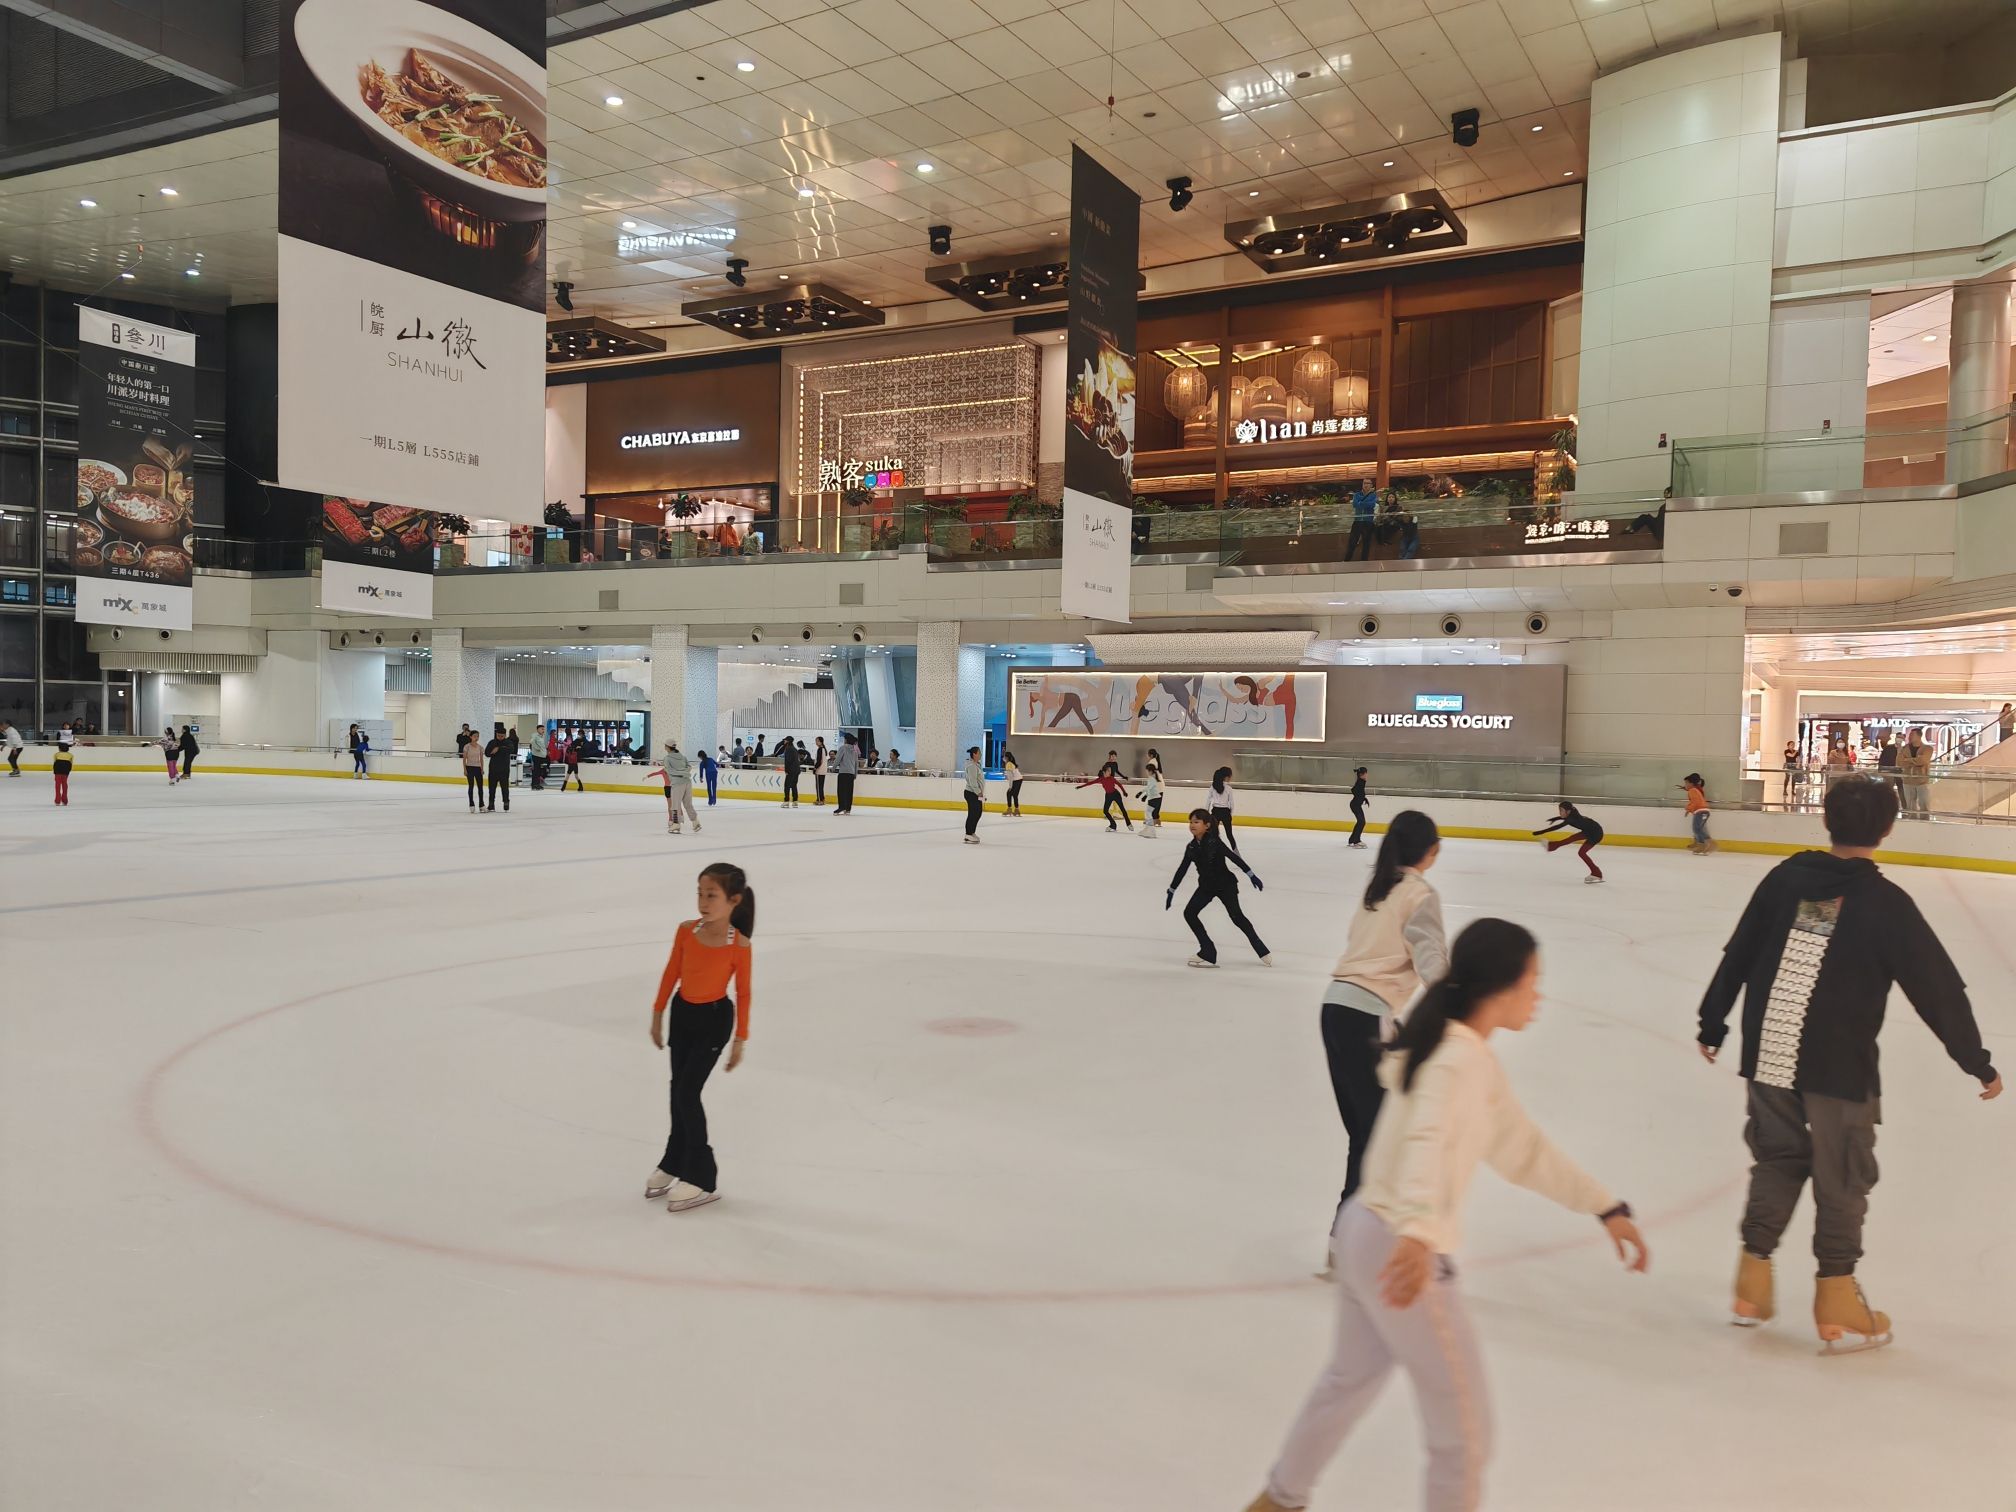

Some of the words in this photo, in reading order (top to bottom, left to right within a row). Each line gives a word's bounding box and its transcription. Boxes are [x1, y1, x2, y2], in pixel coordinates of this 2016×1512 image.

[369, 301, 385, 337] 皖厨
[396, 317, 487, 370] 山徽
[387, 351, 463, 383] SHANHUI
[107, 372, 170, 394] 年轻人的第一口
[106, 383, 170, 407] 川派岁时料理
[360, 434, 417, 455] 一期L5層
[620, 431, 691, 449] CHABUYA
[820, 458, 865, 491] 熟客
[865, 455, 903, 471] suka
[1417, 697, 1461, 709] Blueglass
[1367, 714, 1448, 728] BLUEGLASS
[1450, 715, 1513, 729] YOGURT
